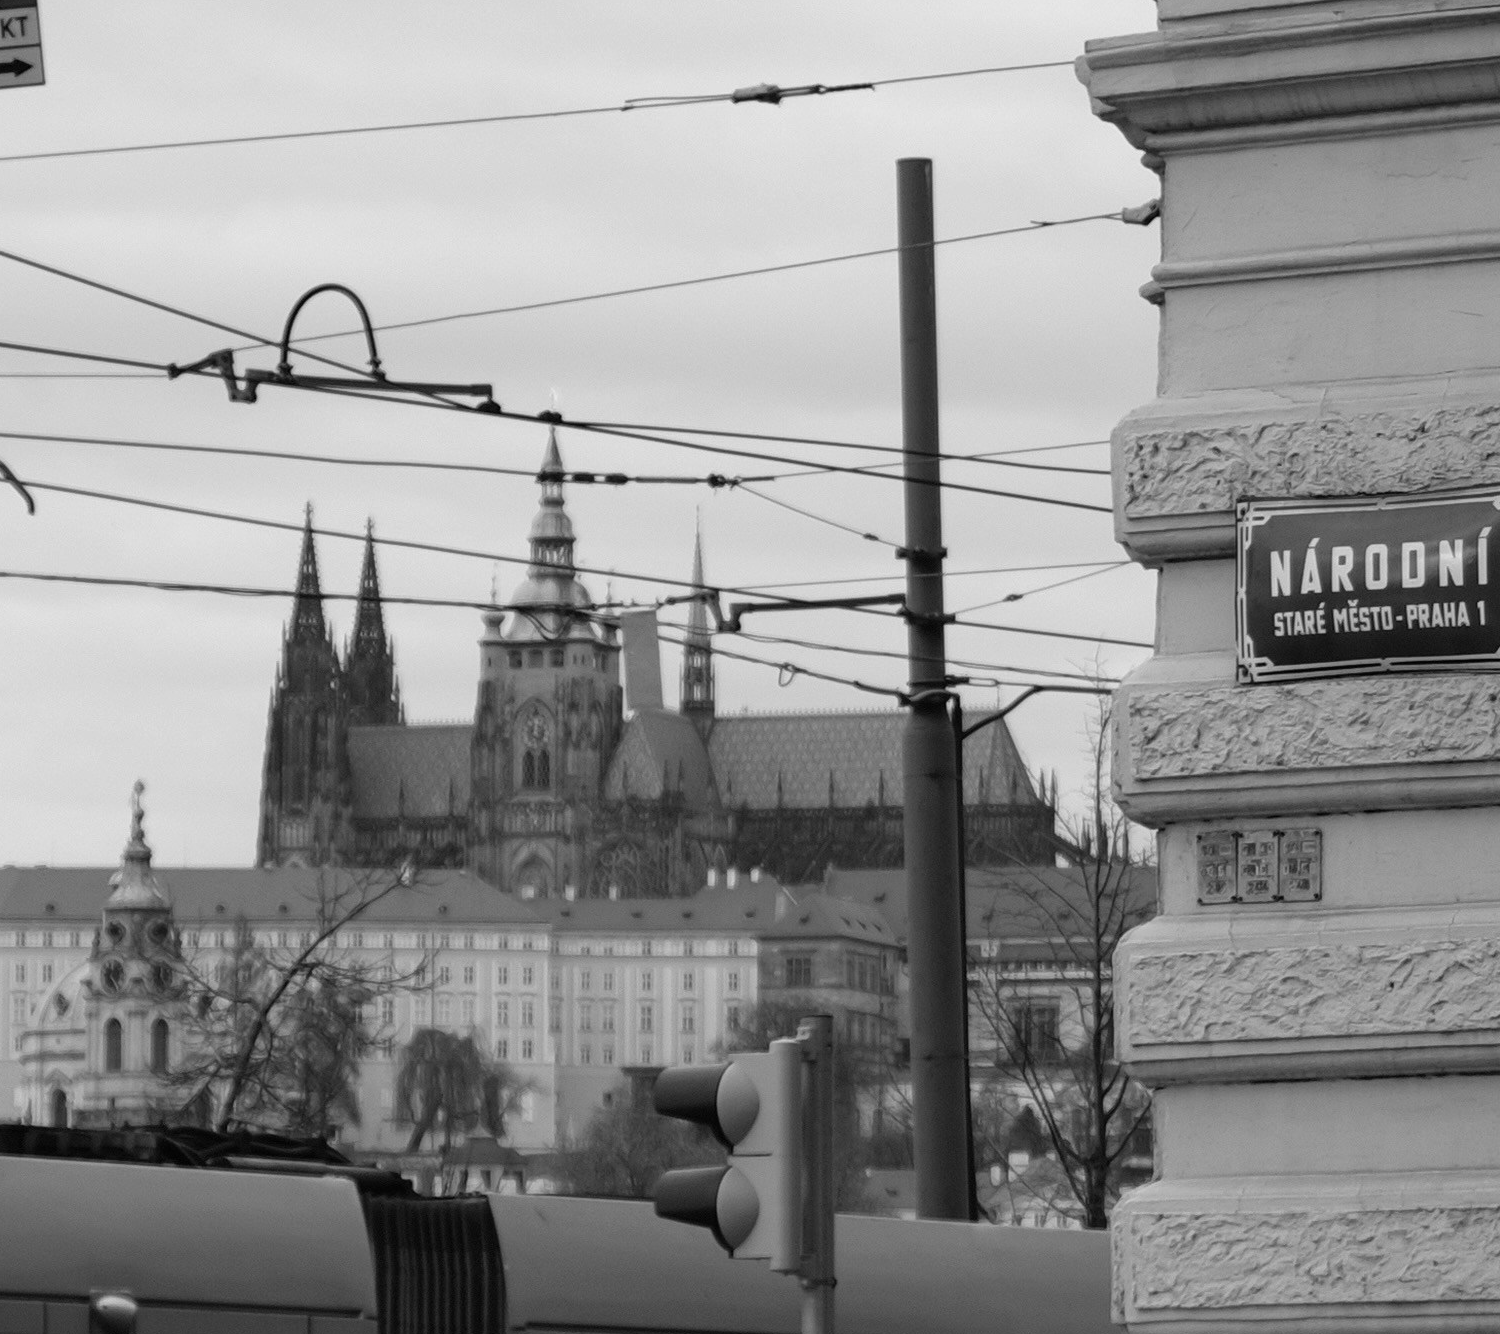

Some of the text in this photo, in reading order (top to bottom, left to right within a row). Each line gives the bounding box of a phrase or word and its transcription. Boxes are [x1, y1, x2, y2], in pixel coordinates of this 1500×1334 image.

[1269, 526, 1493, 598] NÁRODNÍ
[1273, 602, 1326, 637] STARÉ
[1476, 600, 1486, 626] 1
